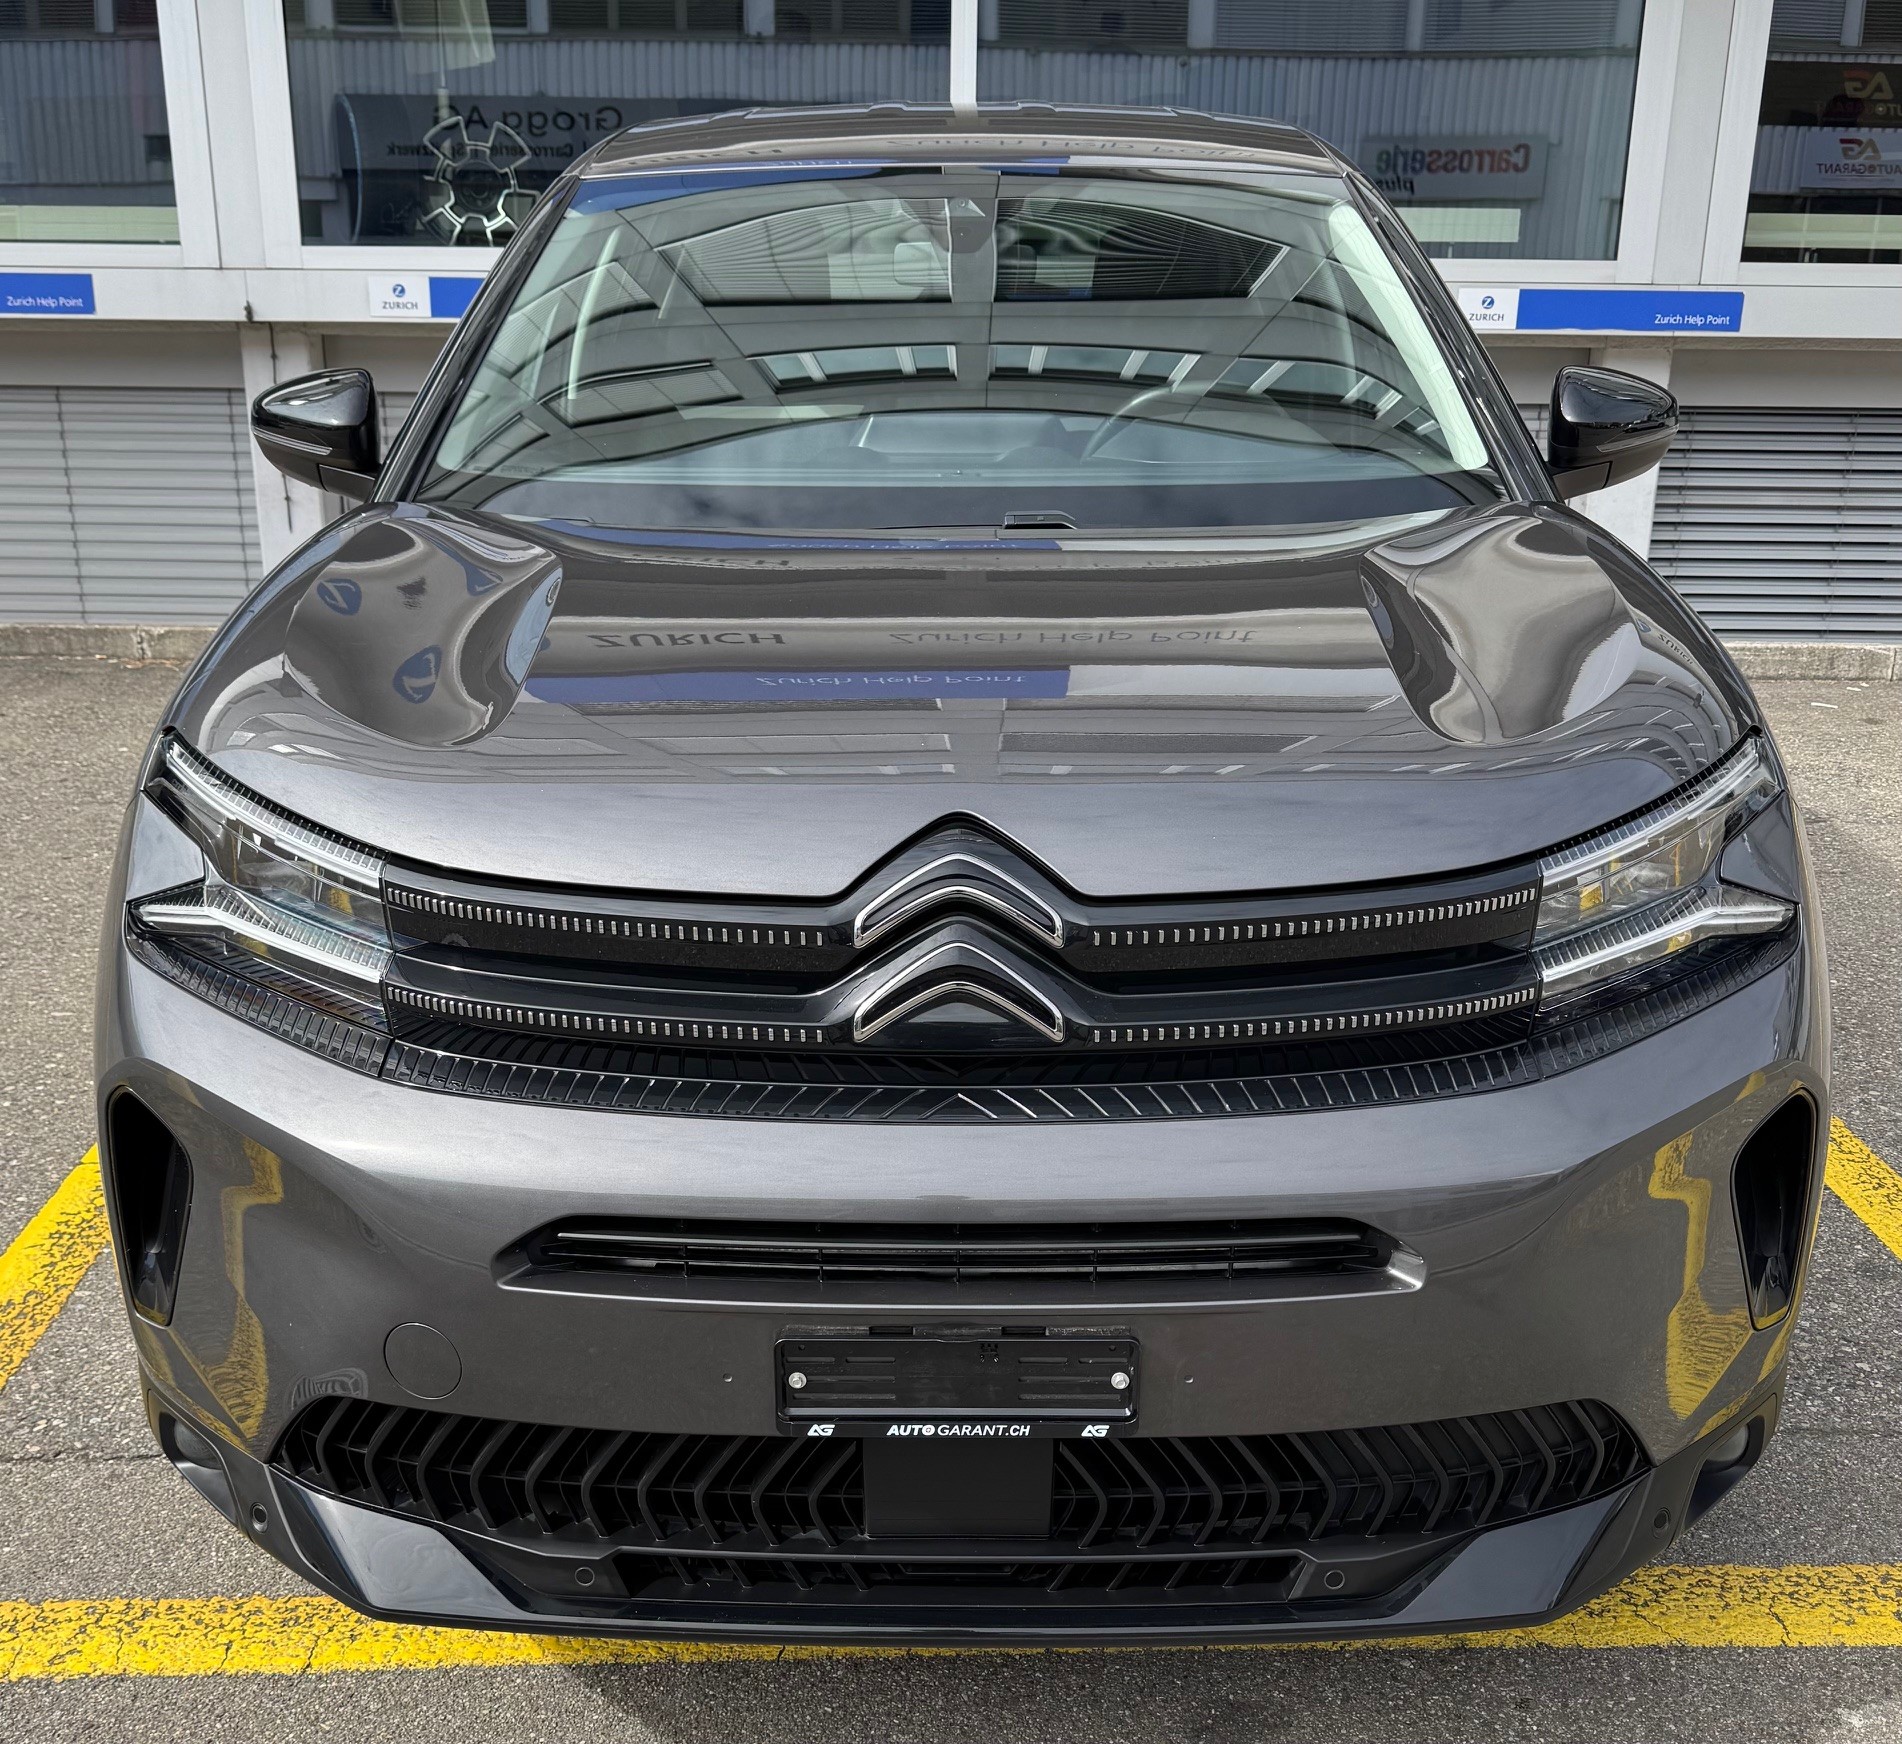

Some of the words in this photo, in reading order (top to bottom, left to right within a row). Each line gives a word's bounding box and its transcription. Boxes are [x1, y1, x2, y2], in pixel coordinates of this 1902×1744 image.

[6, 296, 36, 307] Zurich
[36, 296, 58, 309] Help
[59, 296, 84, 307] Point
[382, 301, 419, 310] ZURICH
[1469, 313, 1505, 322] ZURICH
[1654, 313, 1683, 324] Zurich
[1684, 314, 1705, 327] Help
[1706, 314, 1731, 325] Point
[807, 1424, 836, 1437] AG
[1081, 1424, 1110, 1437] AG
